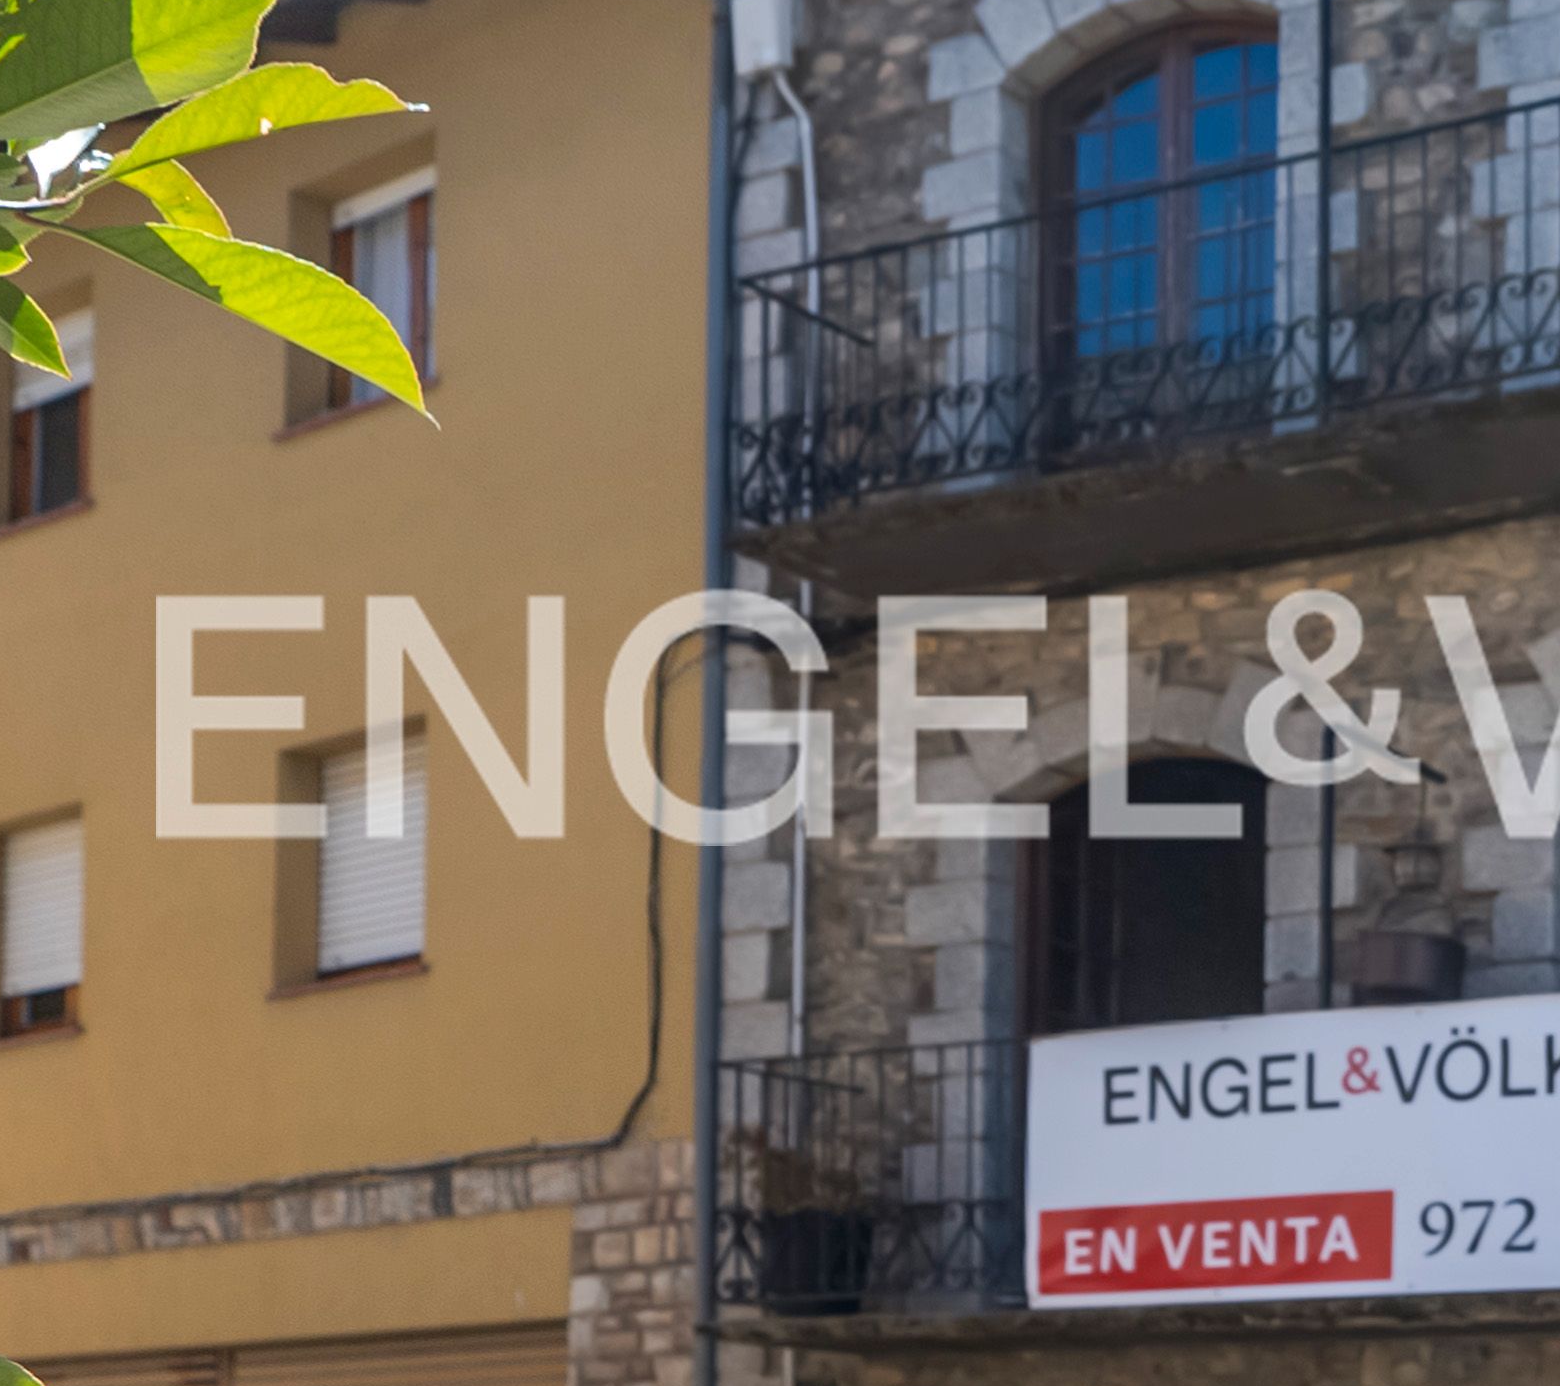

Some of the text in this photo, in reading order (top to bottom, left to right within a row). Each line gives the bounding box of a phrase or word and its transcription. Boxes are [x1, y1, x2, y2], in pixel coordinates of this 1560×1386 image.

[1064, 1214, 1361, 1276] EN VENTA
[1418, 1196, 1539, 1258] 972
